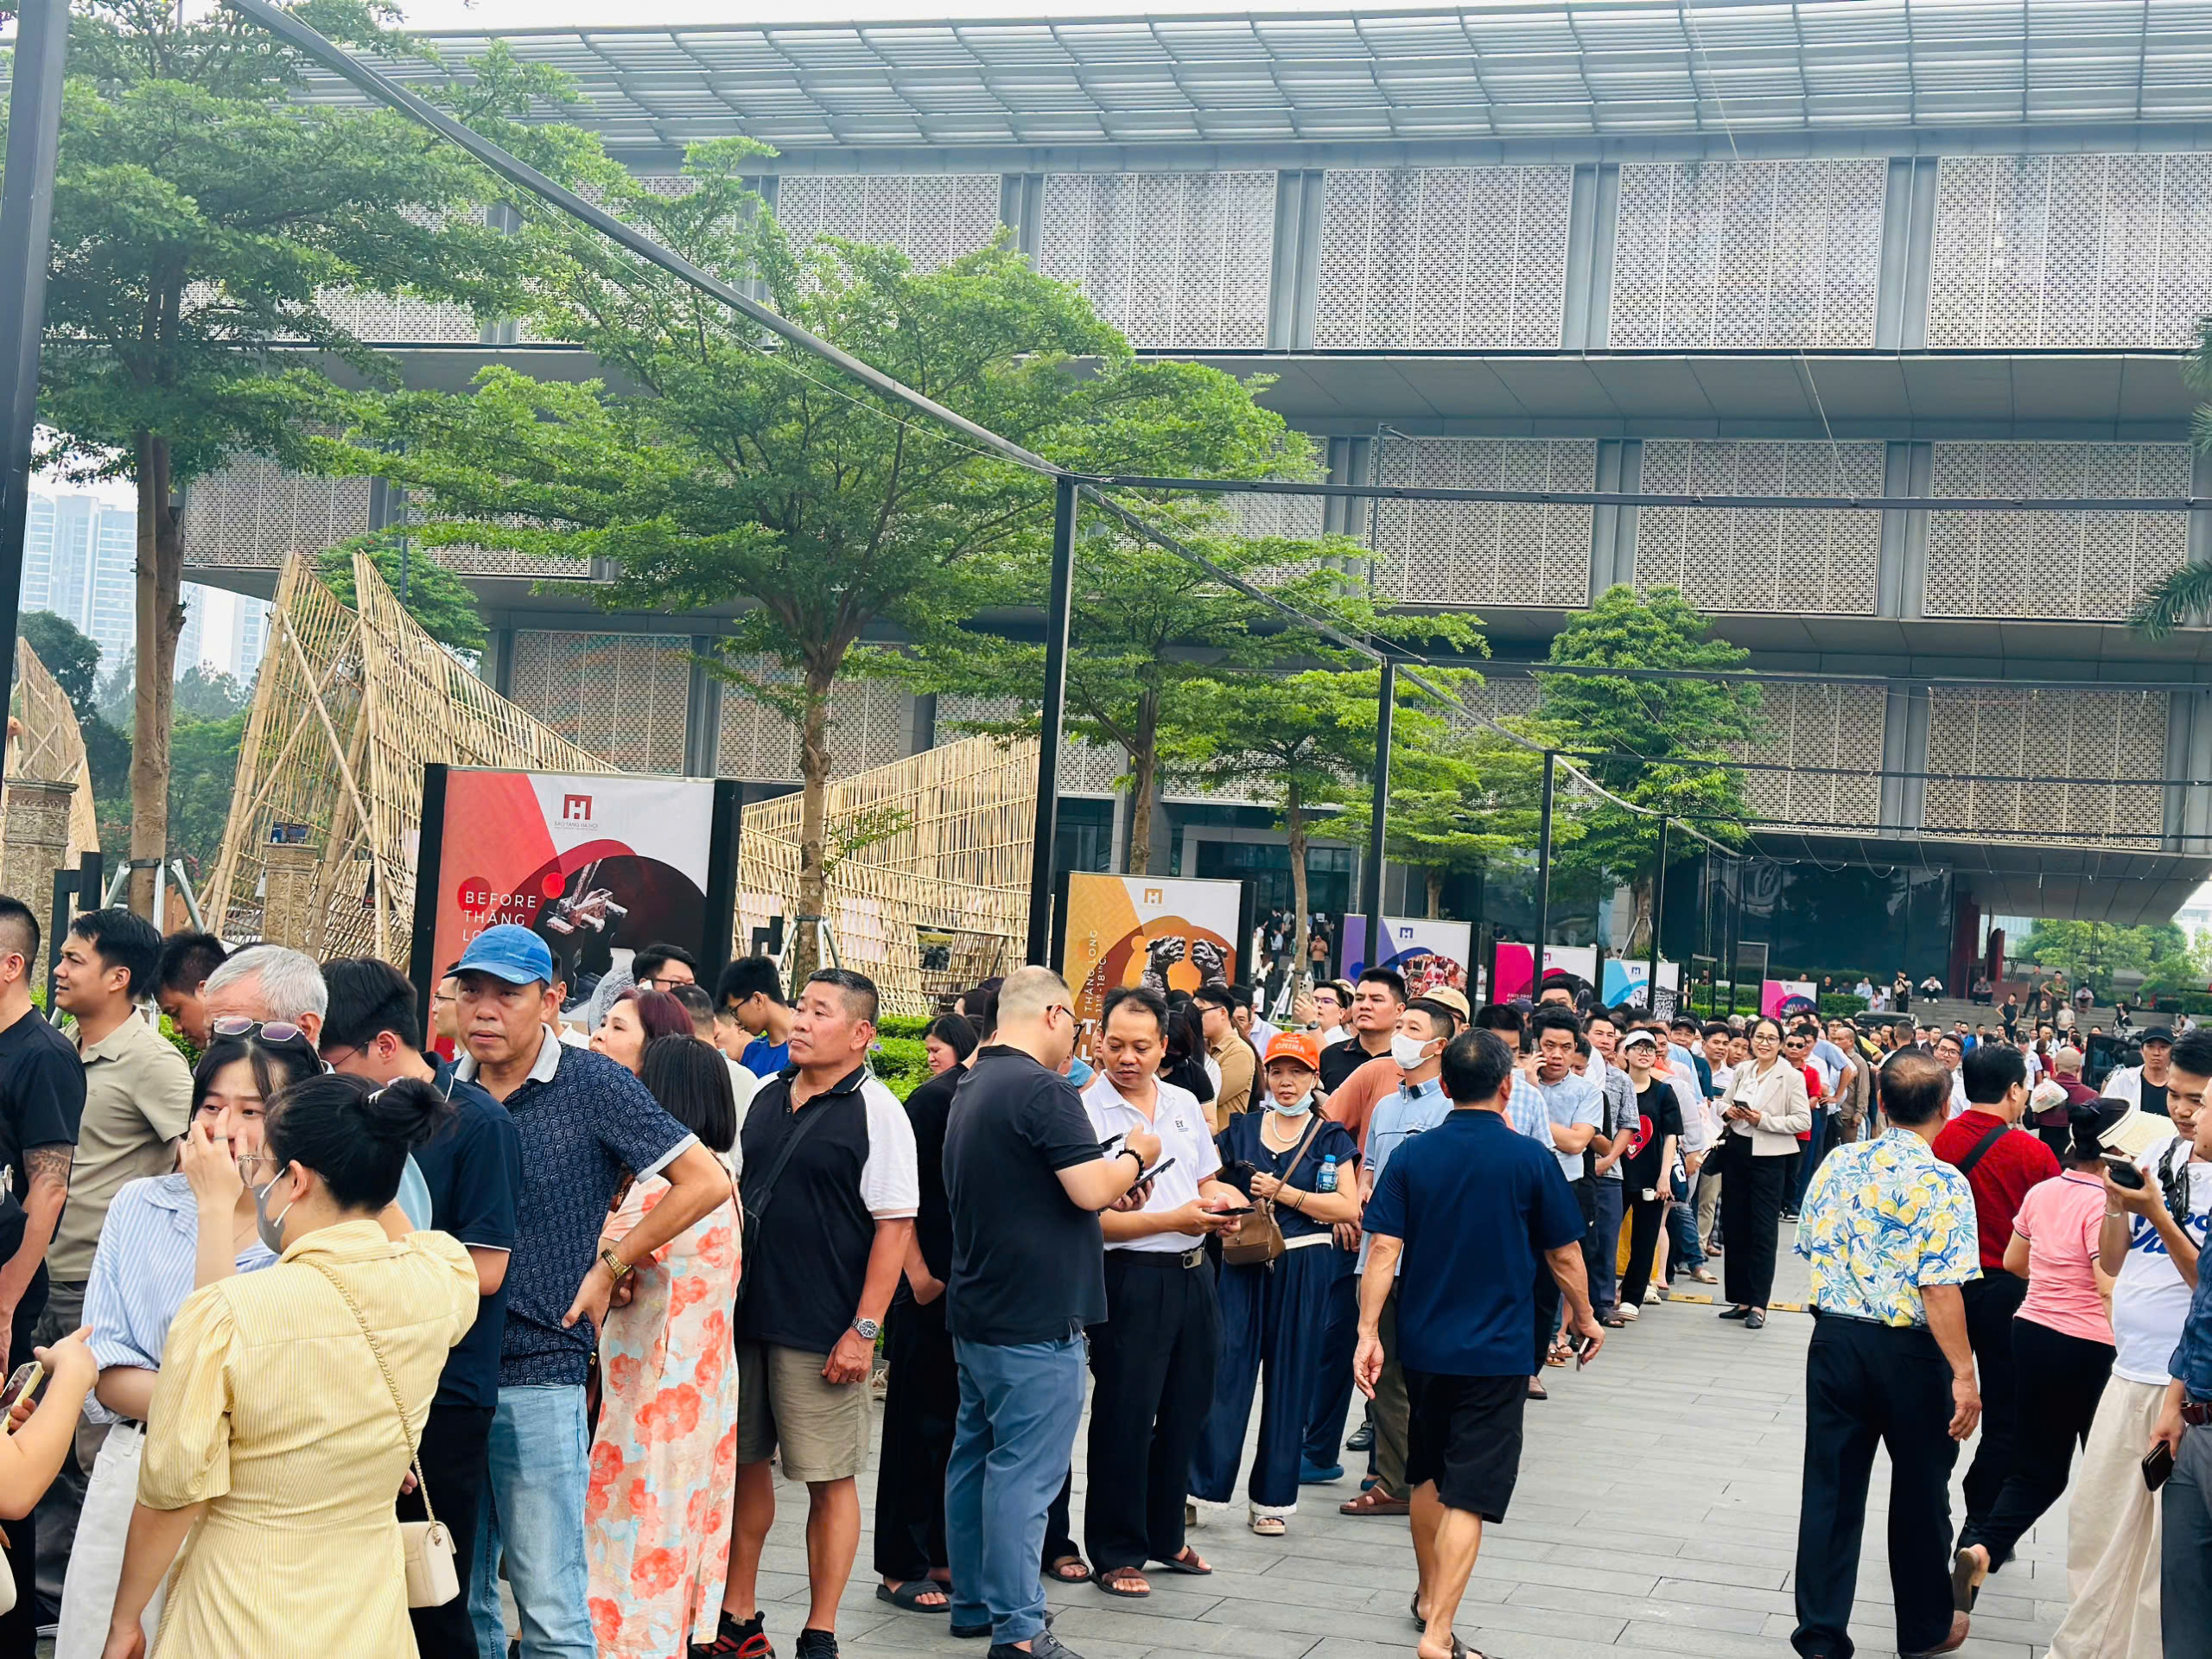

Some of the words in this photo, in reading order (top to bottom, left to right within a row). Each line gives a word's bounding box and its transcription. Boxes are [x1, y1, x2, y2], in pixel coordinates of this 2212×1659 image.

[465, 891, 537, 908] BEFORE
[464, 909, 525, 926] THĂNG
[1089, 930, 1097, 964] LONG
